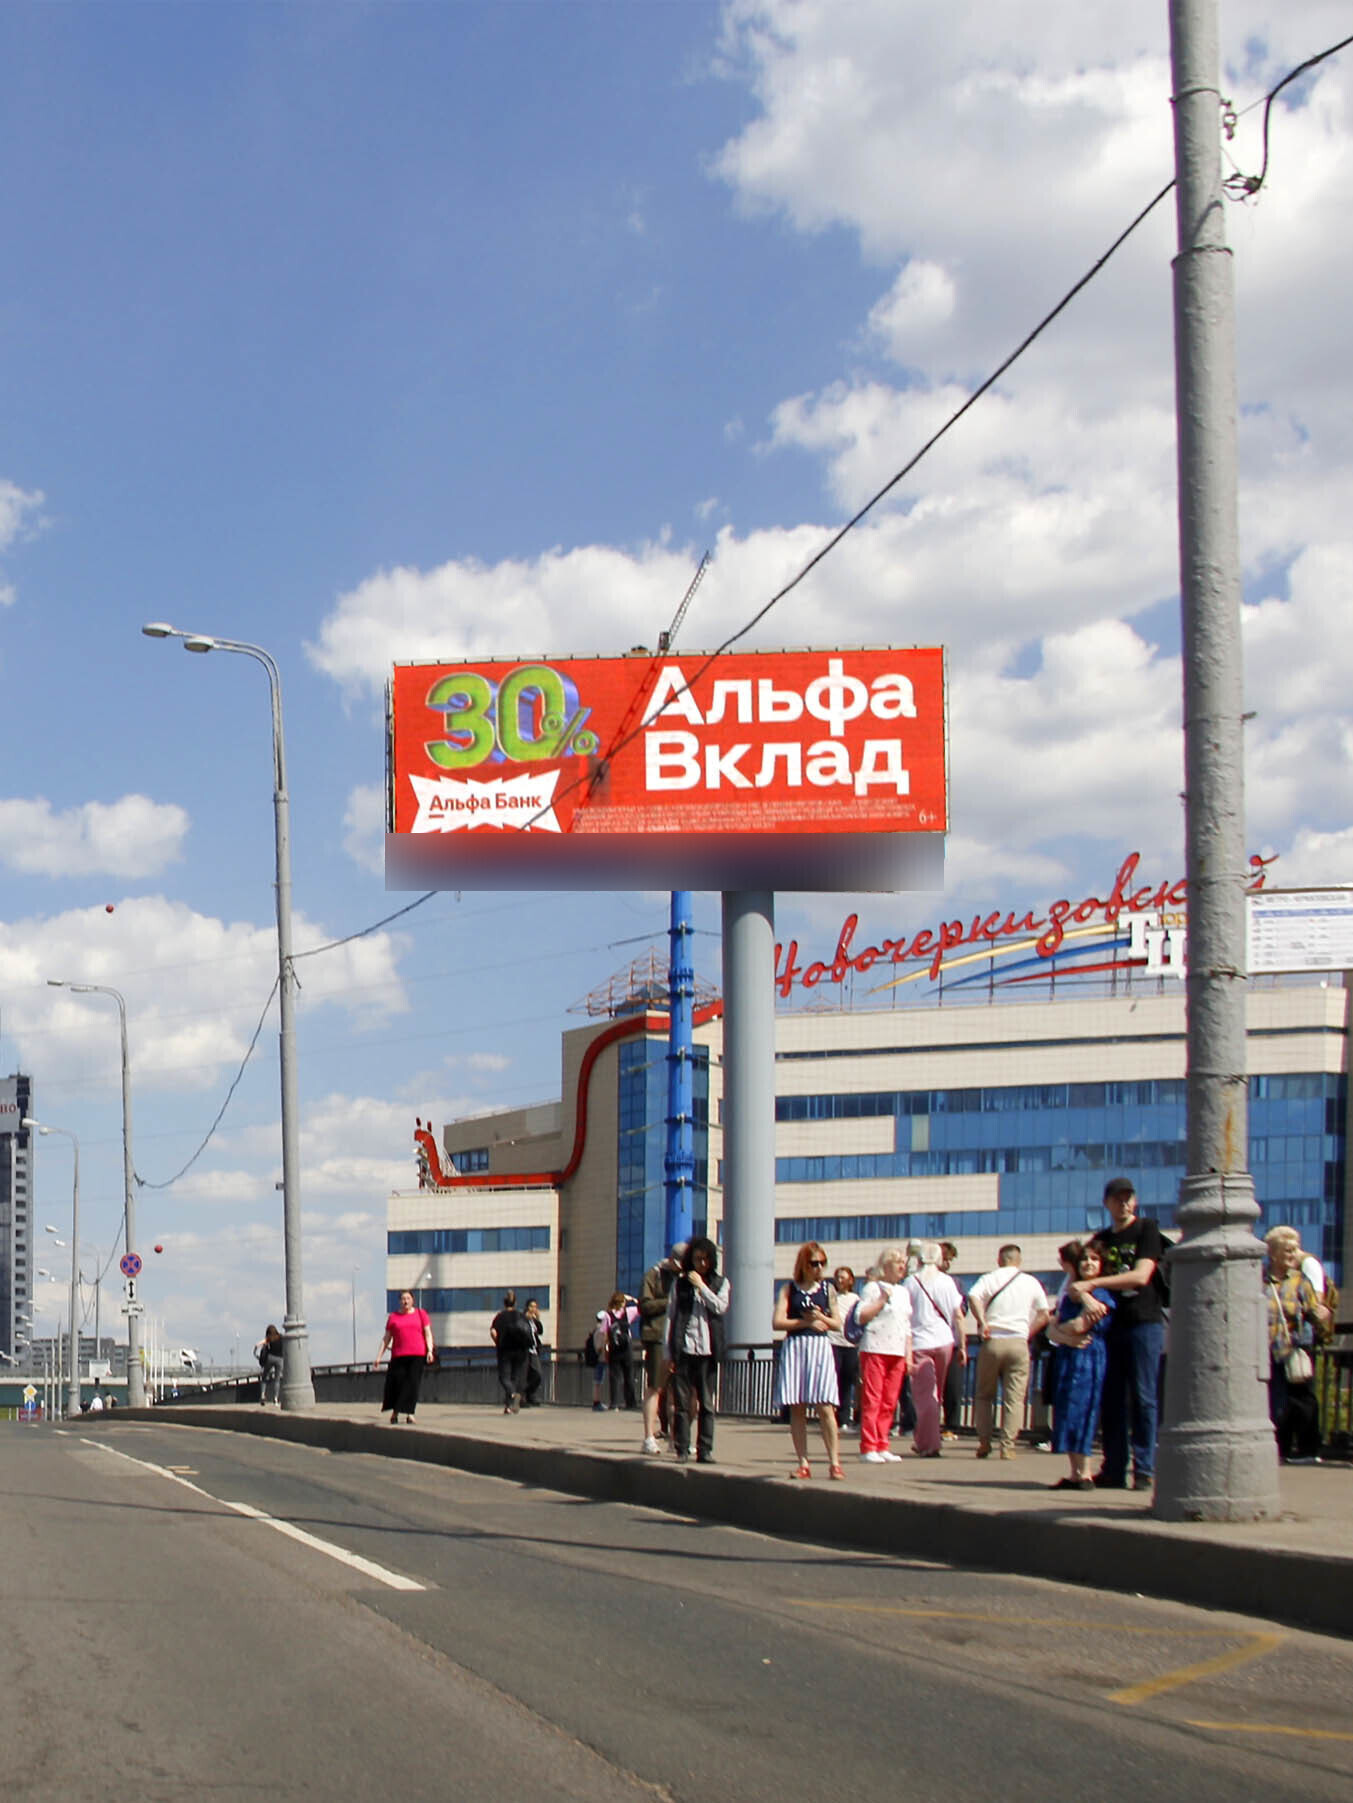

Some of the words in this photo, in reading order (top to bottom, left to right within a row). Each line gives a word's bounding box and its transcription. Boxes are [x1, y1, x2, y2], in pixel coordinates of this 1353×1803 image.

[424, 664, 599, 769] 30%
[640, 659, 917, 736] Альфа
[645, 730, 910, 797] Вклад
[429, 794, 491, 818] Альфа
[495, 793, 542, 810] Банк
[919, 808, 936, 824] 6+
